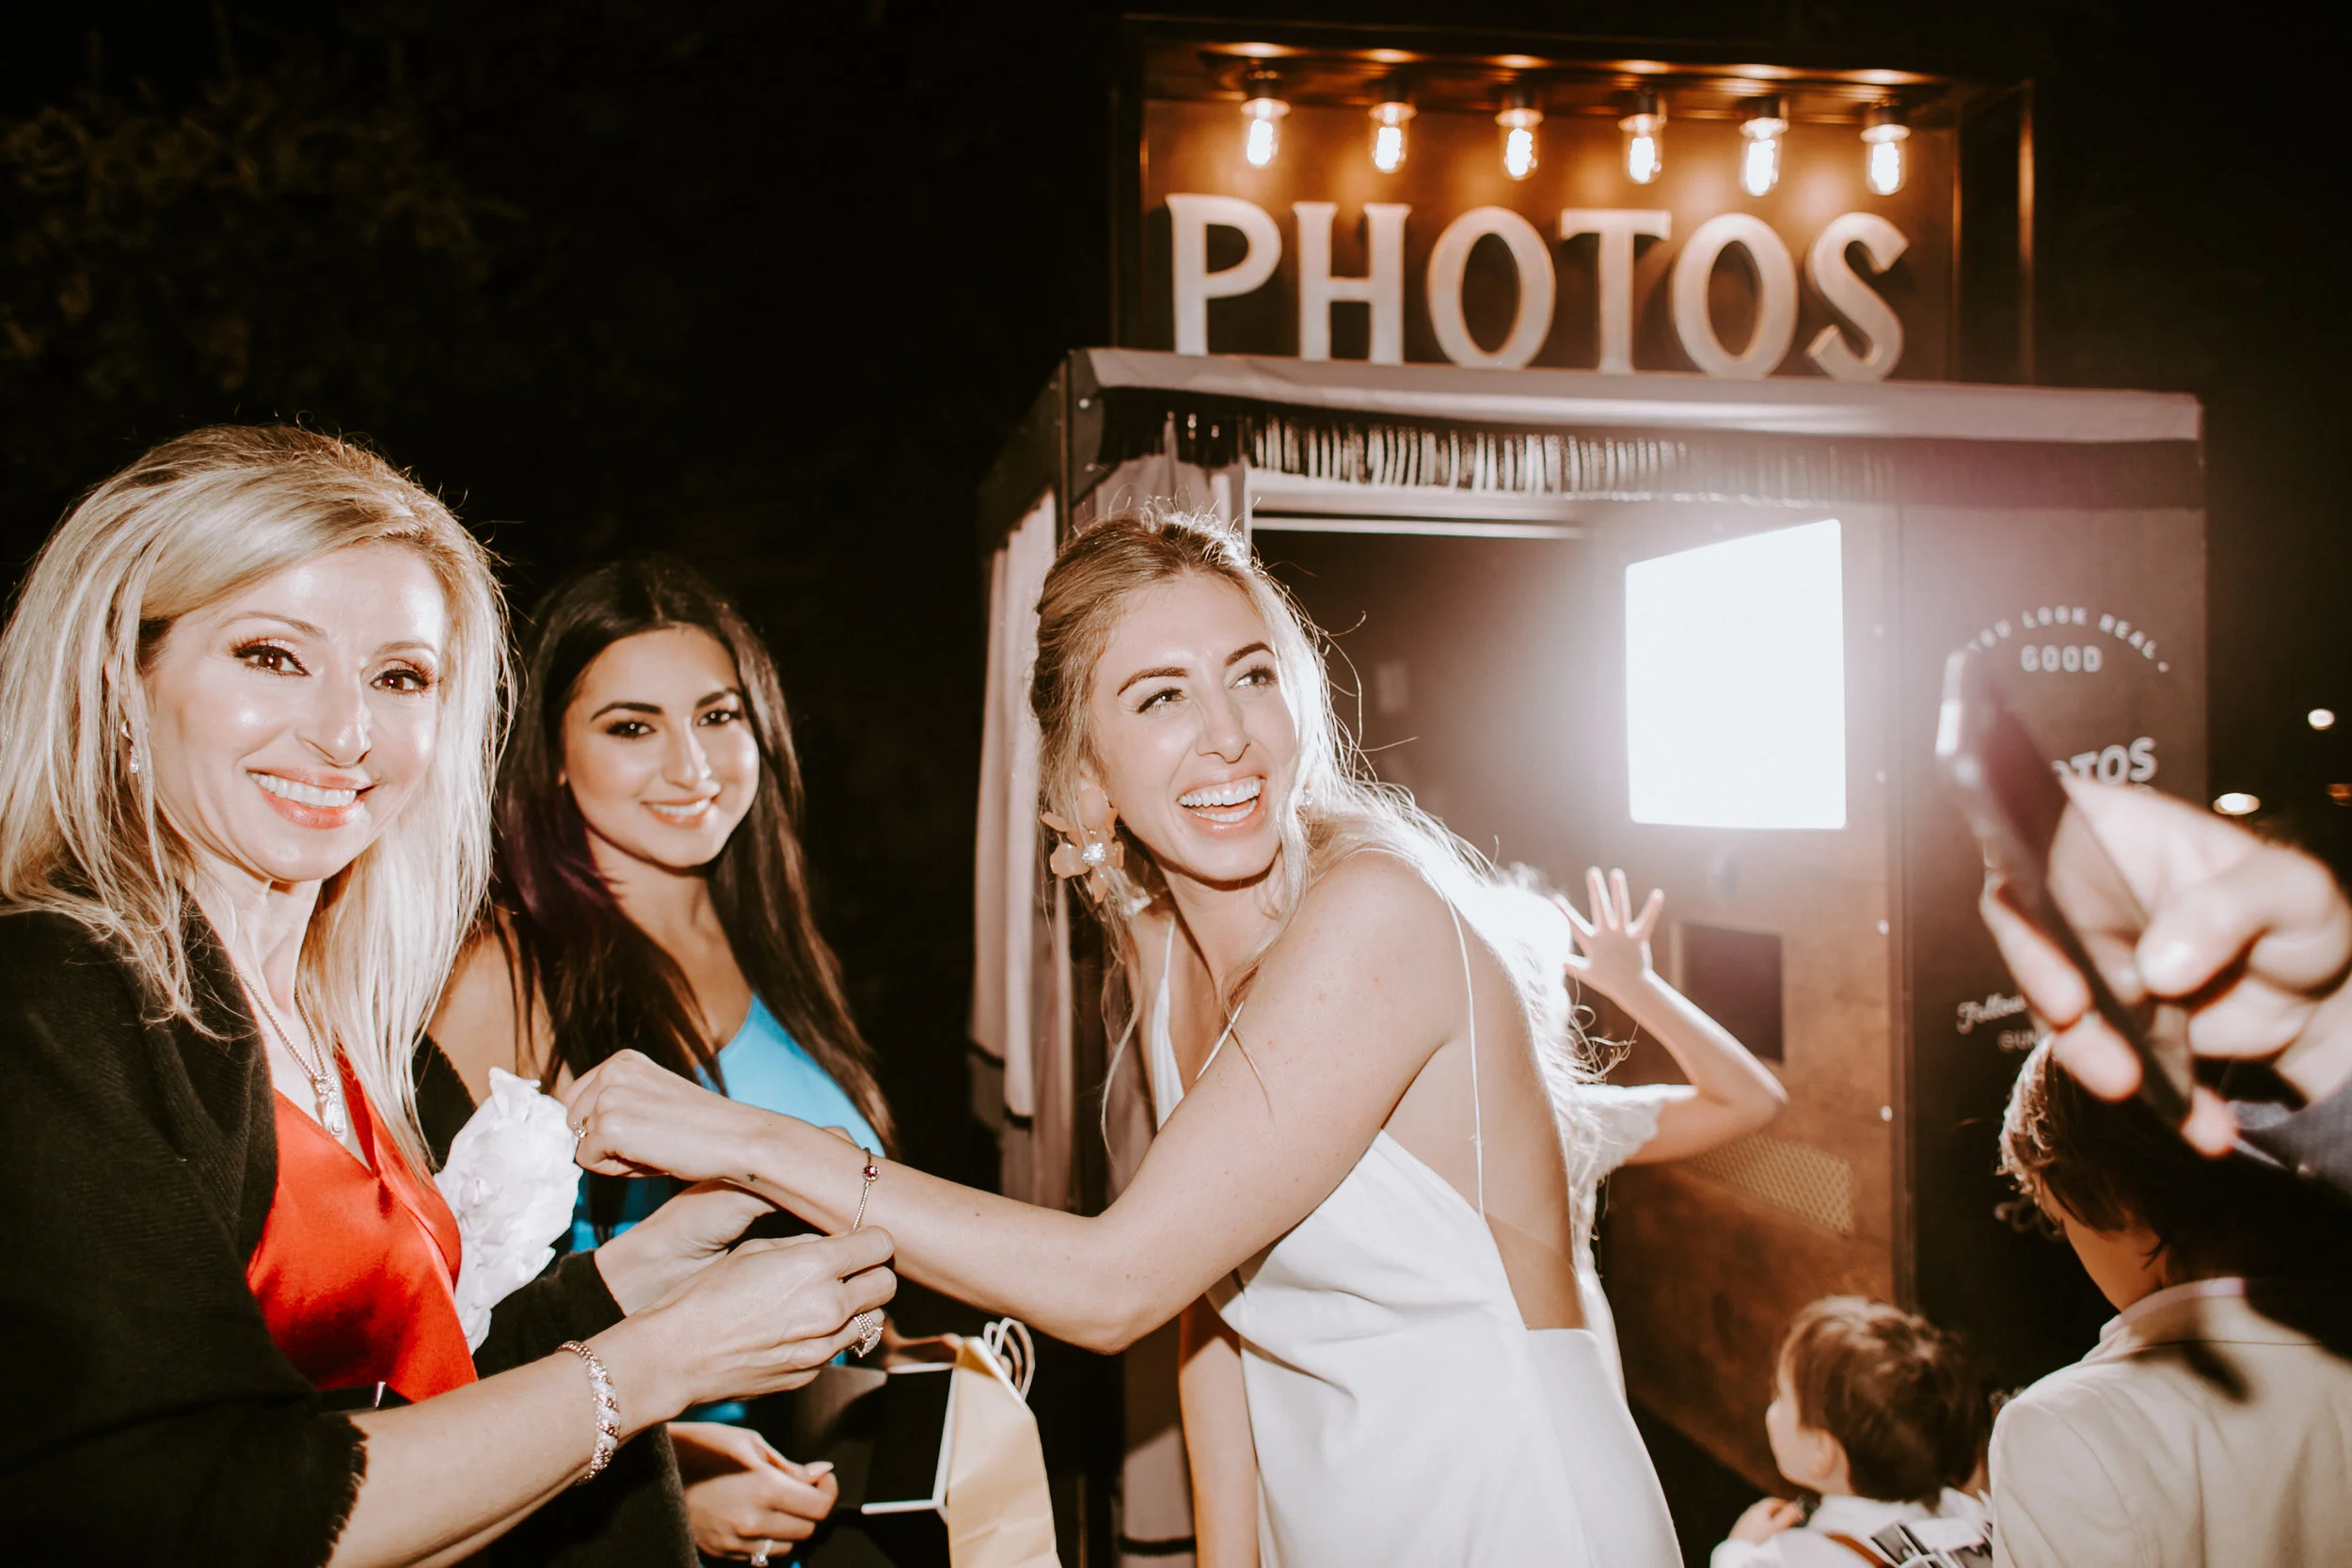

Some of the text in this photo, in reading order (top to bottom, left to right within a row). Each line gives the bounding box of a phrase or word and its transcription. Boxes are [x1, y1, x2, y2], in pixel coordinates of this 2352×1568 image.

[1166, 193, 1910, 379] PHOTOS
[2022, 605, 2088, 629] LOOK
[2020, 644, 2103, 673] GOOD
